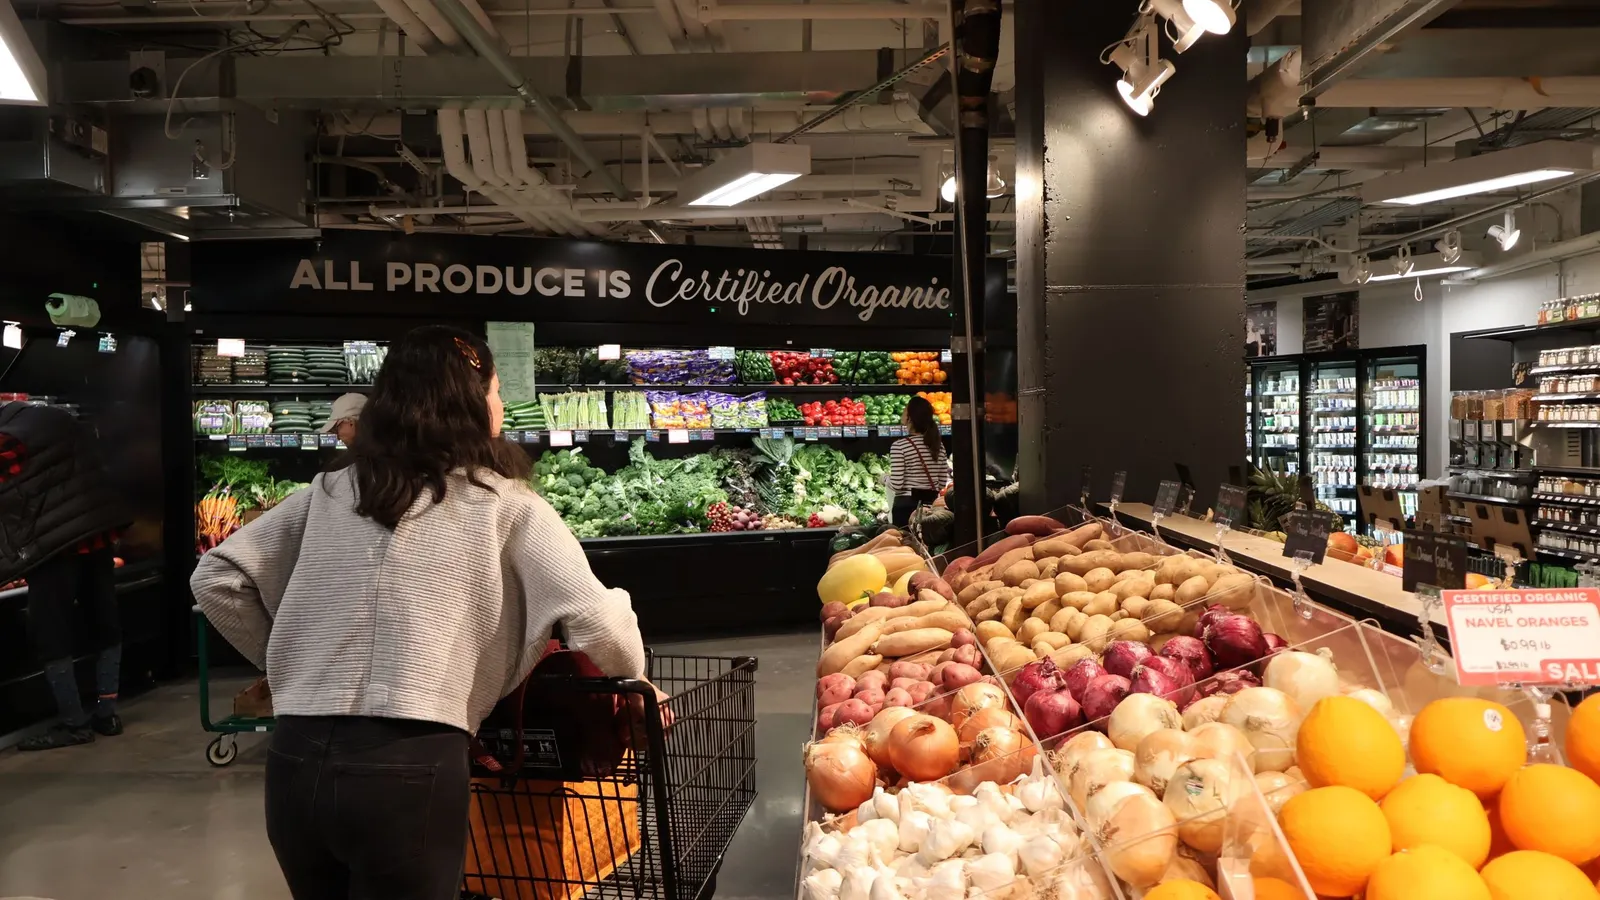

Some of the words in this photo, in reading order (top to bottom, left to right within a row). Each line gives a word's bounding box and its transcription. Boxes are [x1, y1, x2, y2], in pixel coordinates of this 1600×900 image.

[290, 258, 373, 291] ALL
[386, 262, 585, 297] PRODUCE
[598, 269, 631, 298] IS
[646, 258, 809, 316] Certified
[812, 266, 949, 321] Organic
[1453, 593, 1522, 603] CERTIFIED
[1525, 592, 1588, 602] ORGANIC
[1465, 617, 1513, 628] NAVEL
[1517, 616, 1589, 627] ORANGES
[1547, 662, 1600, 681] SAL
